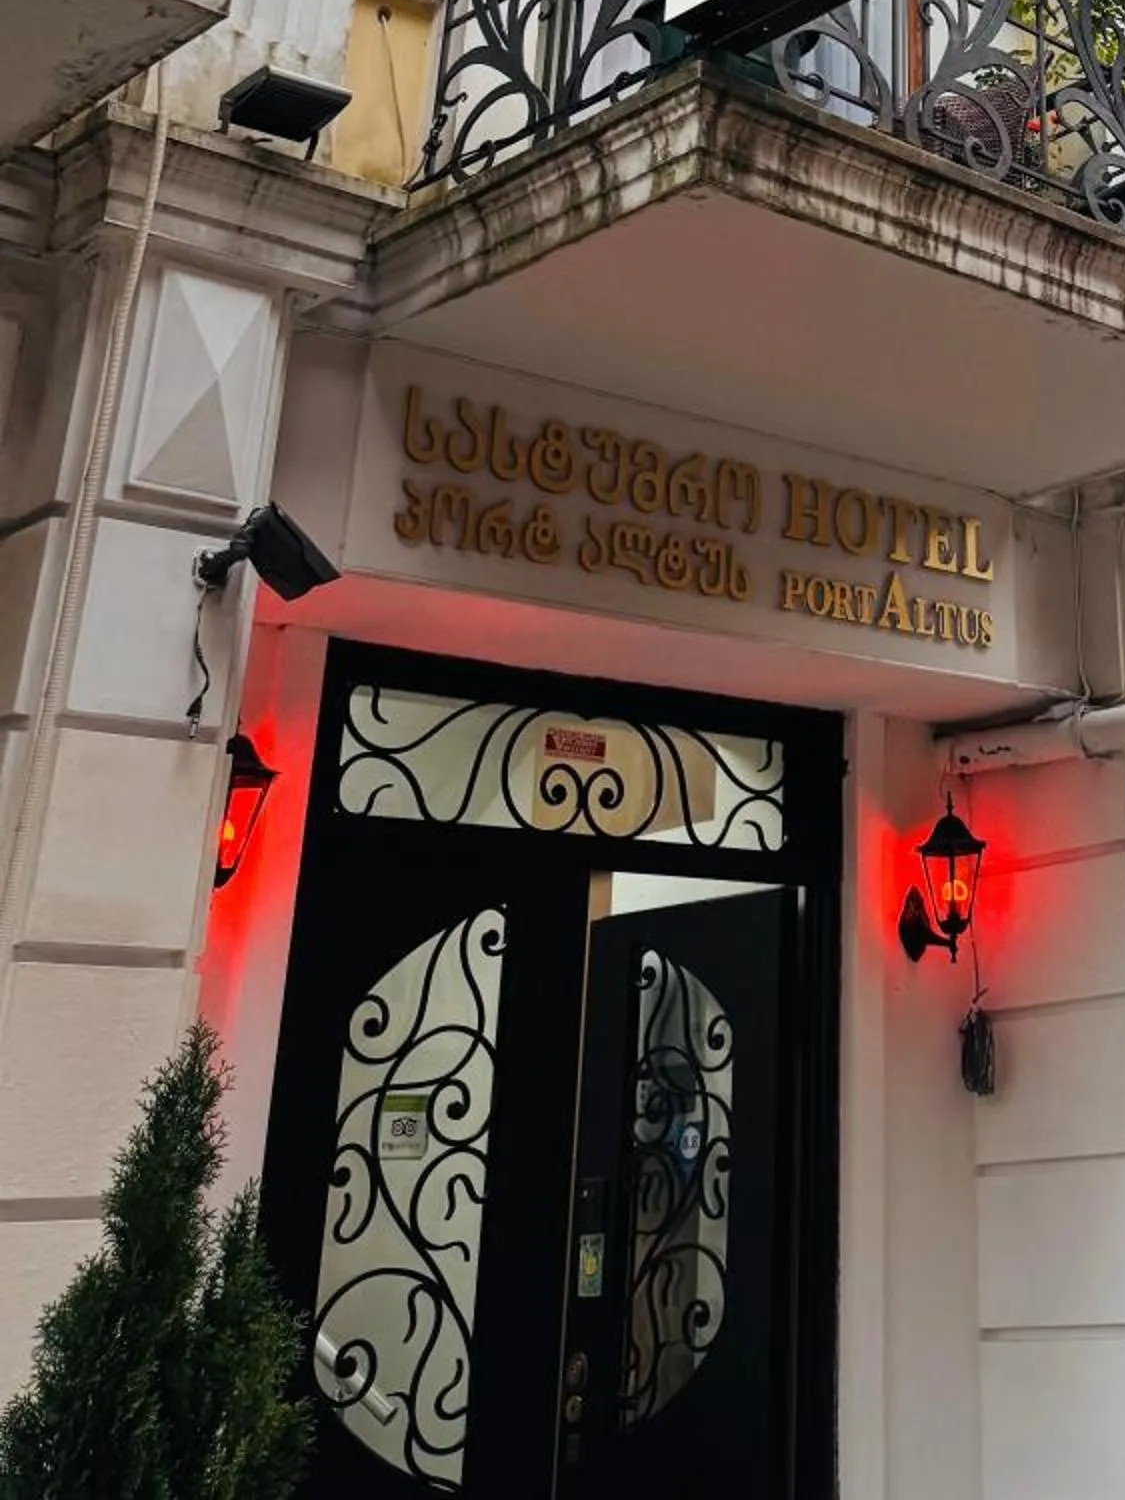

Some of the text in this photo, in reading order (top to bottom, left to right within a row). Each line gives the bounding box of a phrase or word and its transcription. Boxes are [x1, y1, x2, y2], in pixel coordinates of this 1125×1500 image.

[403, 384, 763, 534] სასტუმრო
[394, 478, 751, 601] პორტ ალტუს
[782, 473, 995, 582] HOTEL
